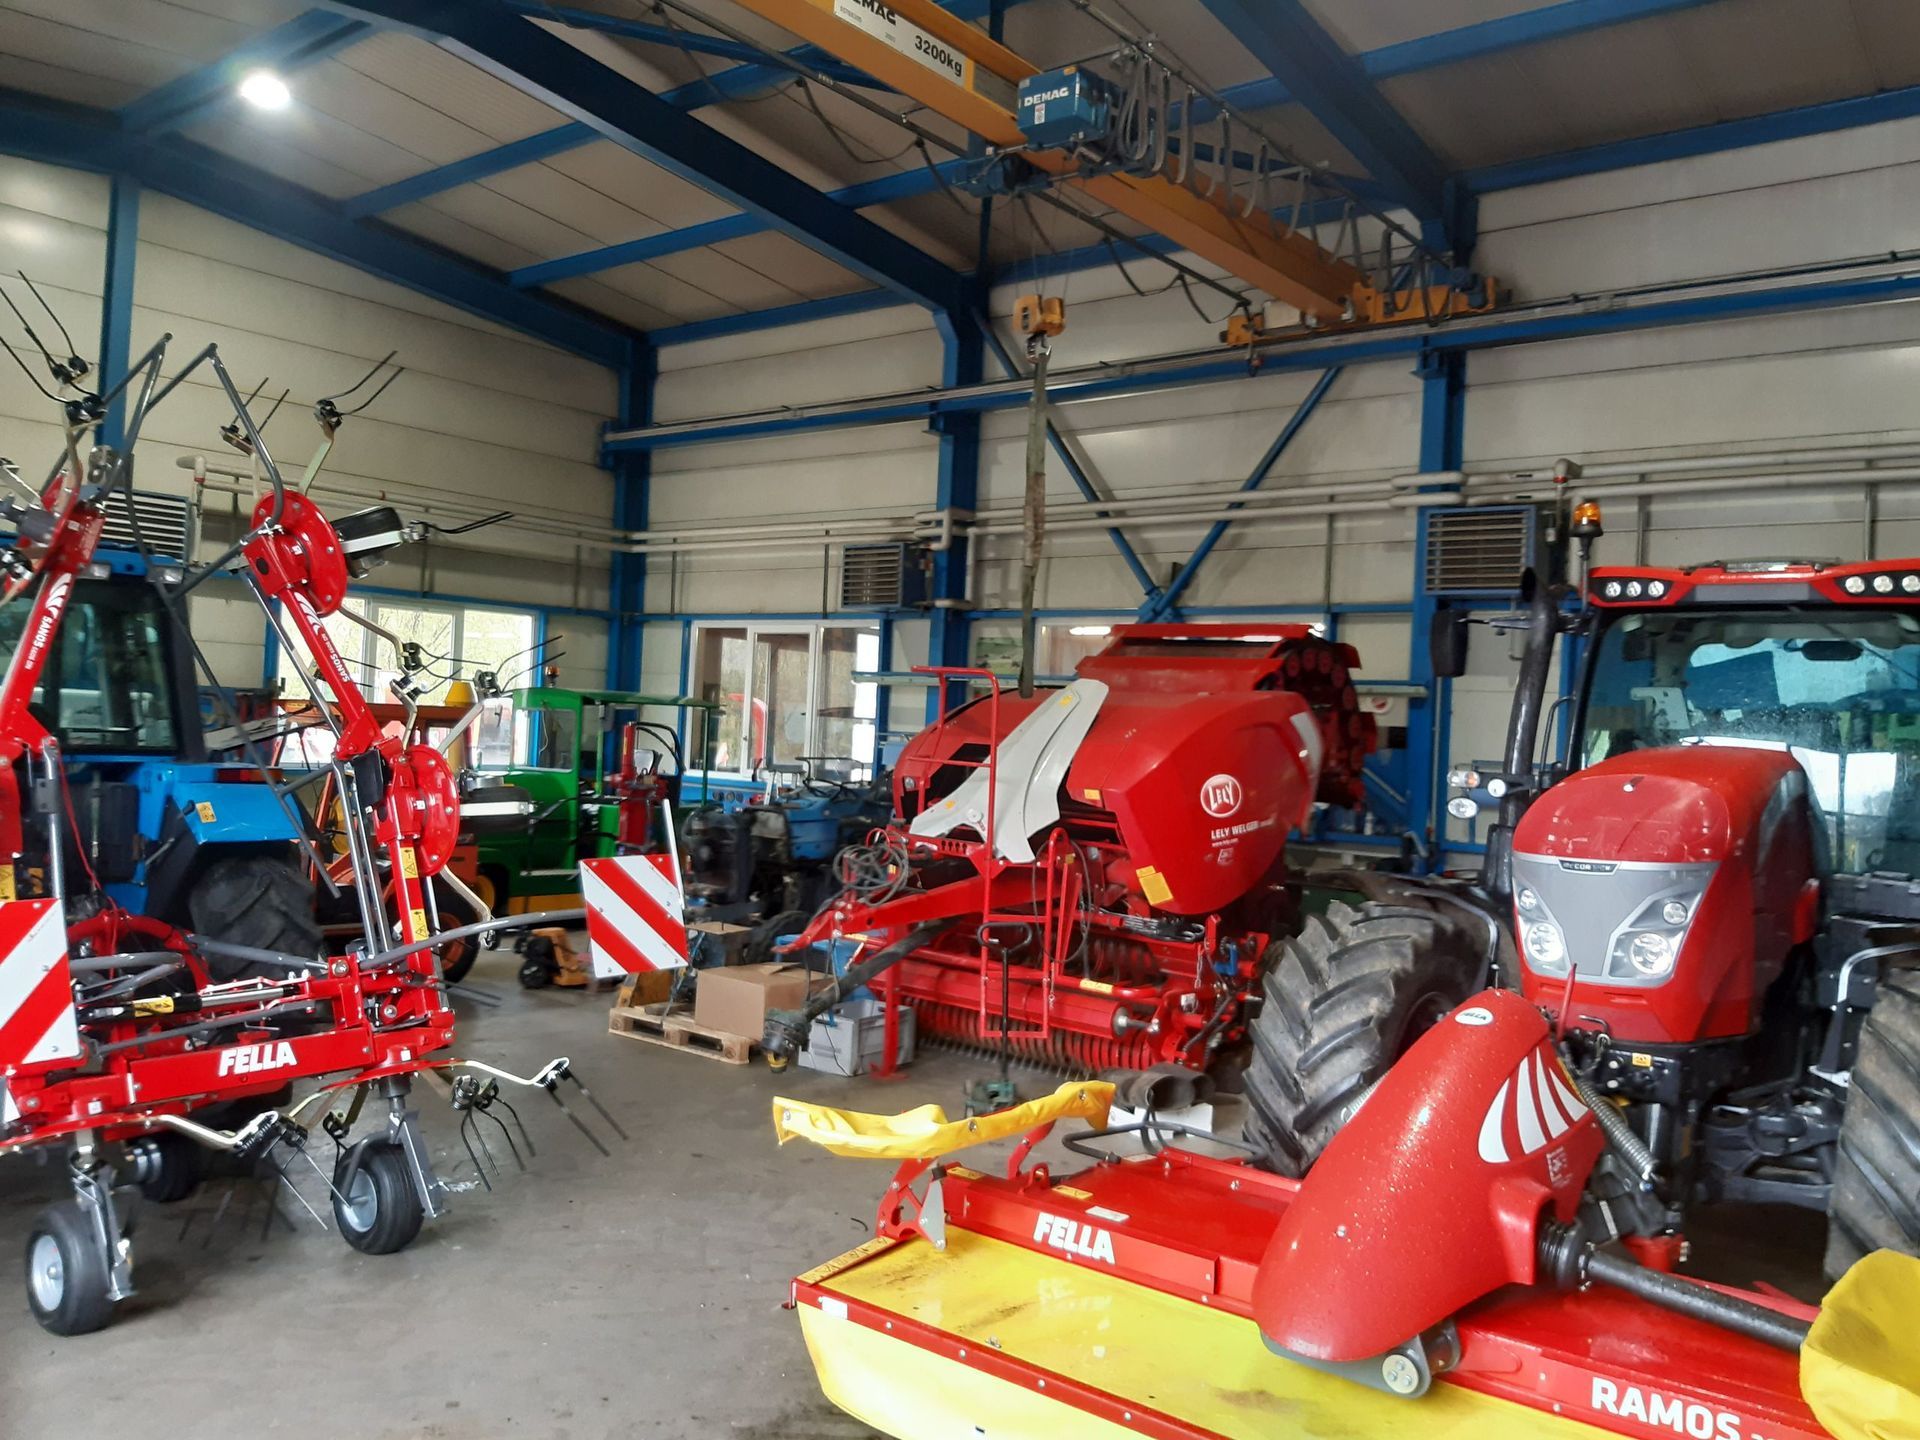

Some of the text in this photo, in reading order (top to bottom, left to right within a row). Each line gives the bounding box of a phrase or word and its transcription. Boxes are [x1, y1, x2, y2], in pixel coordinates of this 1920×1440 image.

[915, 35, 962, 77] 3200kg
[1023, 87, 1069, 107] DEMAG
[33, 615, 53, 648] SANOS
[330, 653, 351, 682] SANOS
[1208, 781, 1234, 811] LELY
[1210, 827, 1230, 840] LELY
[218, 1041, 298, 1077] FELLA
[1033, 1211, 1116, 1265] FELLA
[1591, 1376, 1740, 1440] RAMOS
